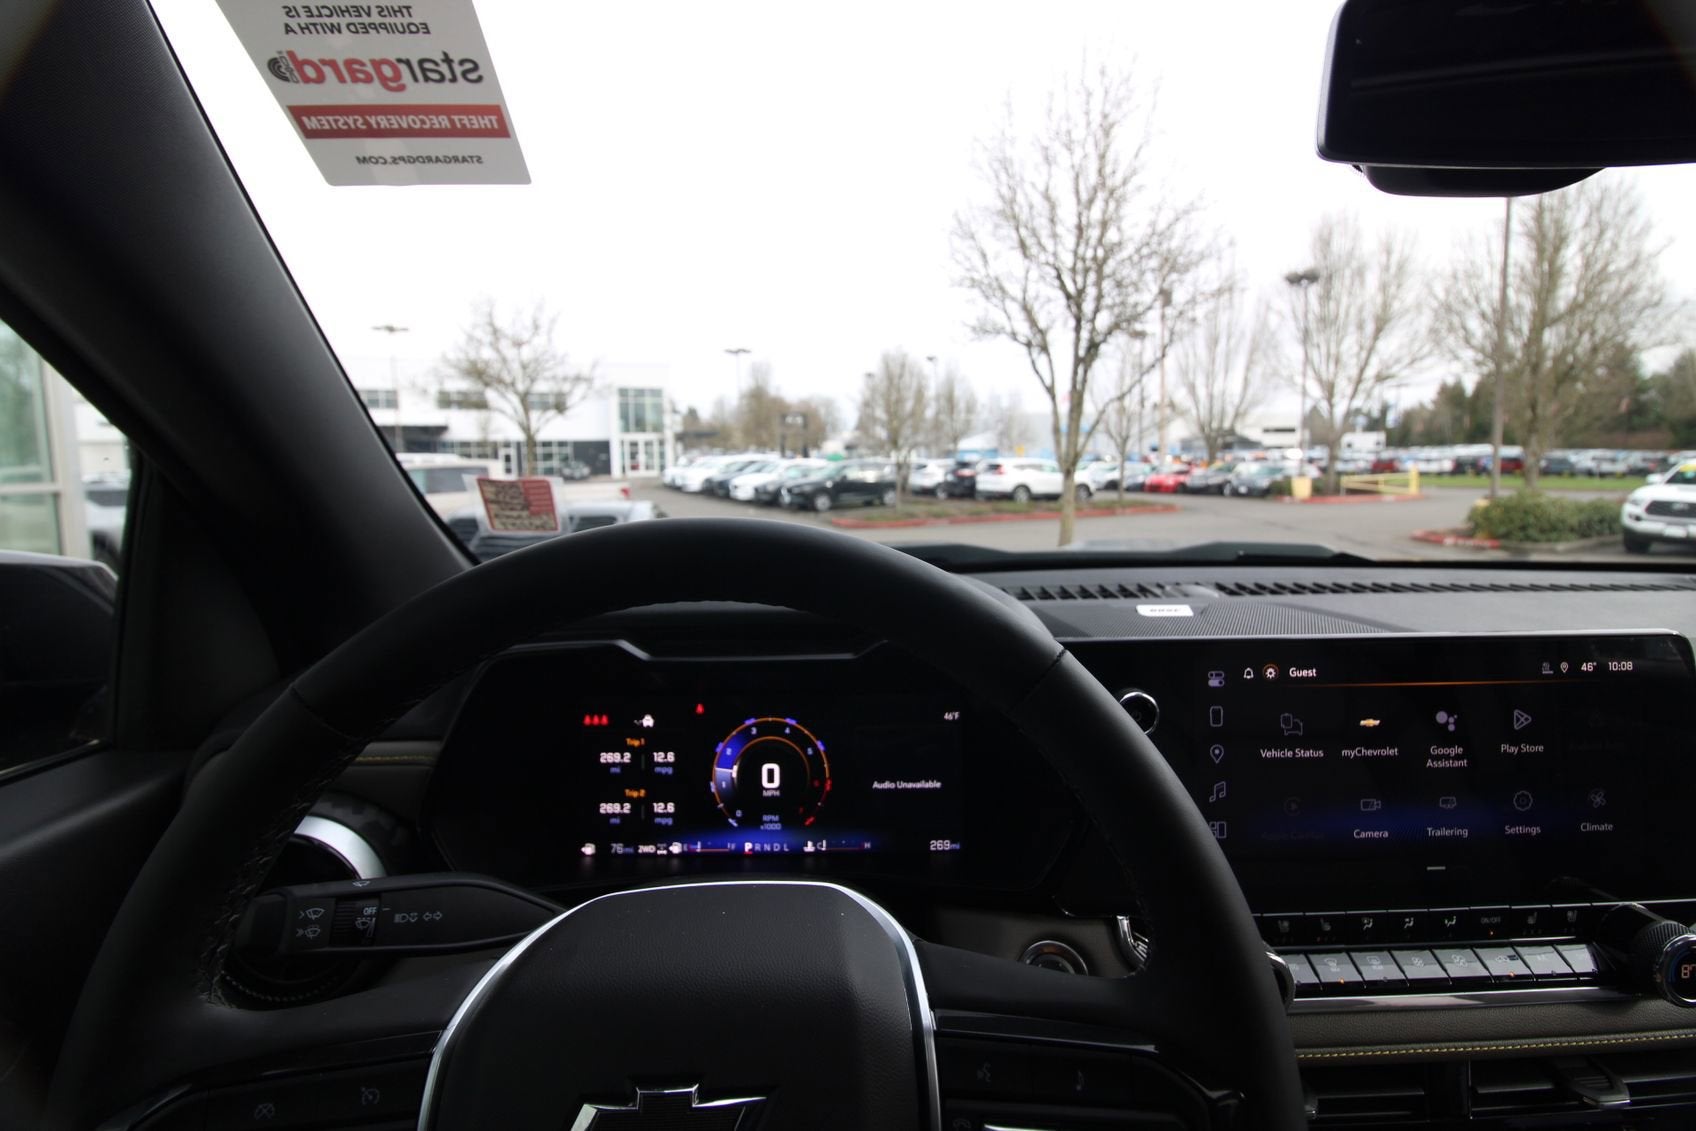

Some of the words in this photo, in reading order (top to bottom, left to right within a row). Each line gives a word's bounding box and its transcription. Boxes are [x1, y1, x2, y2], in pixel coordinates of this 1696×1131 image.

[1580, 661, 1597, 672] 46°
[1608, 661, 1634, 672] 10:08
[1289, 667, 1317, 678] Guest
[1260, 748, 1294, 759] Vehicle
[1294, 747, 1324, 758] Status
[1341, 746, 1399, 759] myChevrolet
[1430, 745, 1464, 757] Google
[1501, 744, 1519, 755] Play
[1520, 743, 1545, 754] Store
[599, 752, 632, 763] 269.2
[652, 751, 675, 763] 12.6
[1426, 758, 1468, 769] Assistant
[654, 766, 673, 776] mpg
[761, 763, 781, 789] 0
[872, 780, 897, 789] Audio
[897, 780, 942, 789] Unavailable
[599, 802, 632, 814] 269.2
[652, 802, 675, 813] 12.6
[654, 817, 673, 826] mpg
[762, 814, 780, 822] RPM
[1426, 826, 1470, 838] Trailering
[1504, 824, 1542, 836] Settings
[1580, 822, 1614, 832] Climate
[1353, 828, 1389, 838] Camera
[362, 906, 377, 916] OFF
